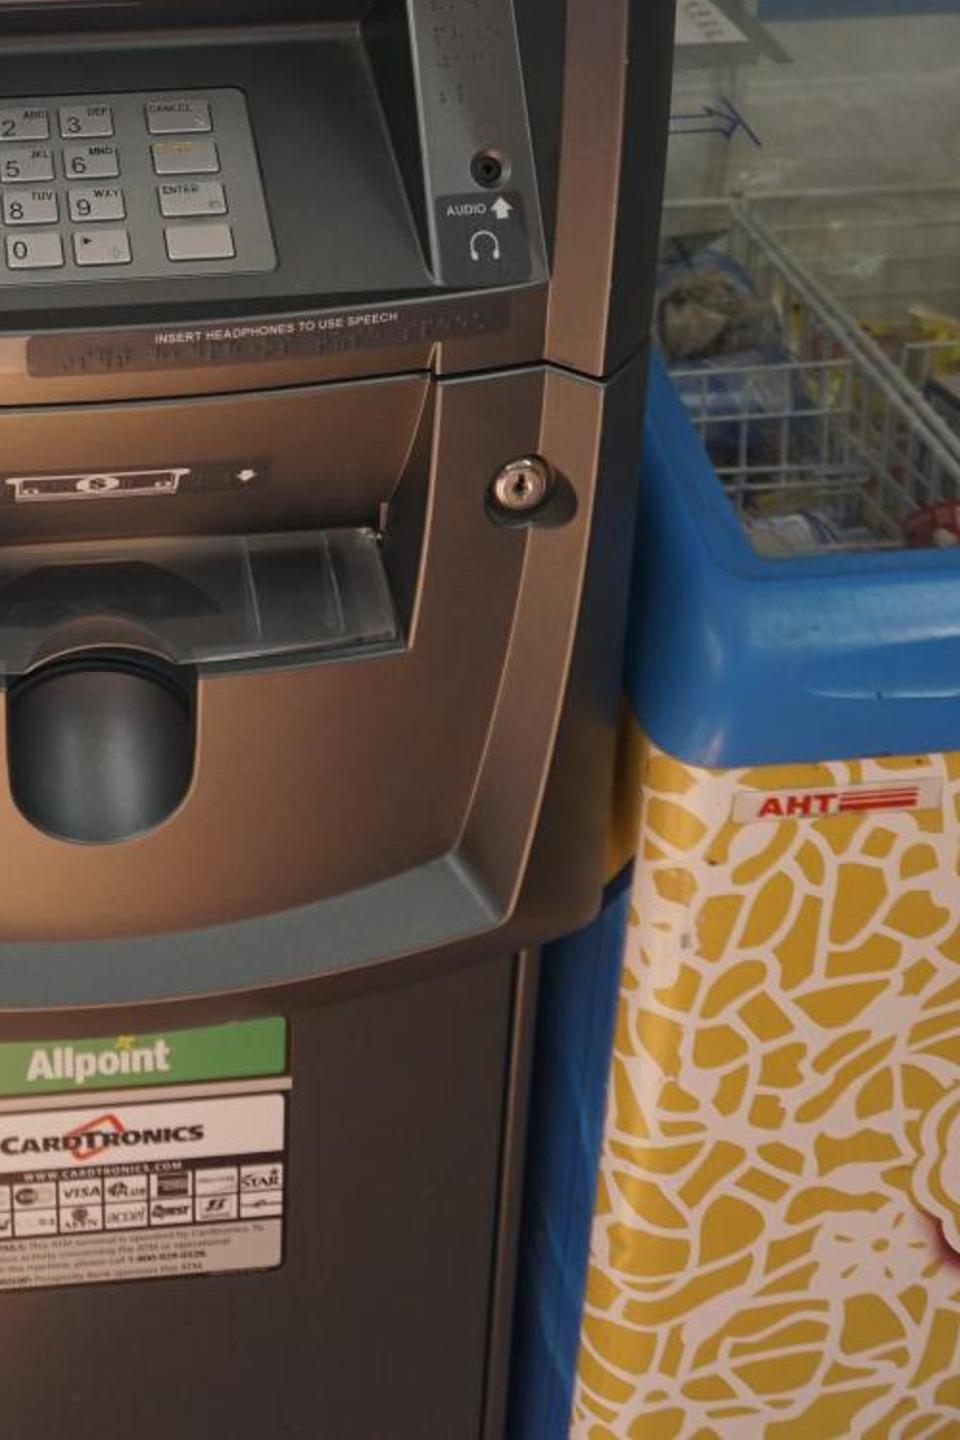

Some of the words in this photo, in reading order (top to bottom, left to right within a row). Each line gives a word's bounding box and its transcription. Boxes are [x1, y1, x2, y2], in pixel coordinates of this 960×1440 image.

[1, 120, 16, 137] 2
[67, 116, 82, 134] 3
[6, 160, 20, 178] 5
[71, 156, 86, 174] 6
[9, 201, 25, 220] 8
[76, 198, 92, 216] 9
[446, 203, 487, 217] AUDIO
[12, 241, 28, 260] 0
[154, 331, 202, 345] INSERT
[205, 324, 295, 341] HEADPHONES
[298, 321, 317, 333] TO
[318, 318, 344, 331] USE
[347, 311, 400, 327] SPEECH
[757, 793, 836, 817] AHT
[26, 1036, 172, 1083] Allpoint
[0, 1124, 205, 1156] CARDTRONICS
[63, 1184, 102, 1199] VISA
